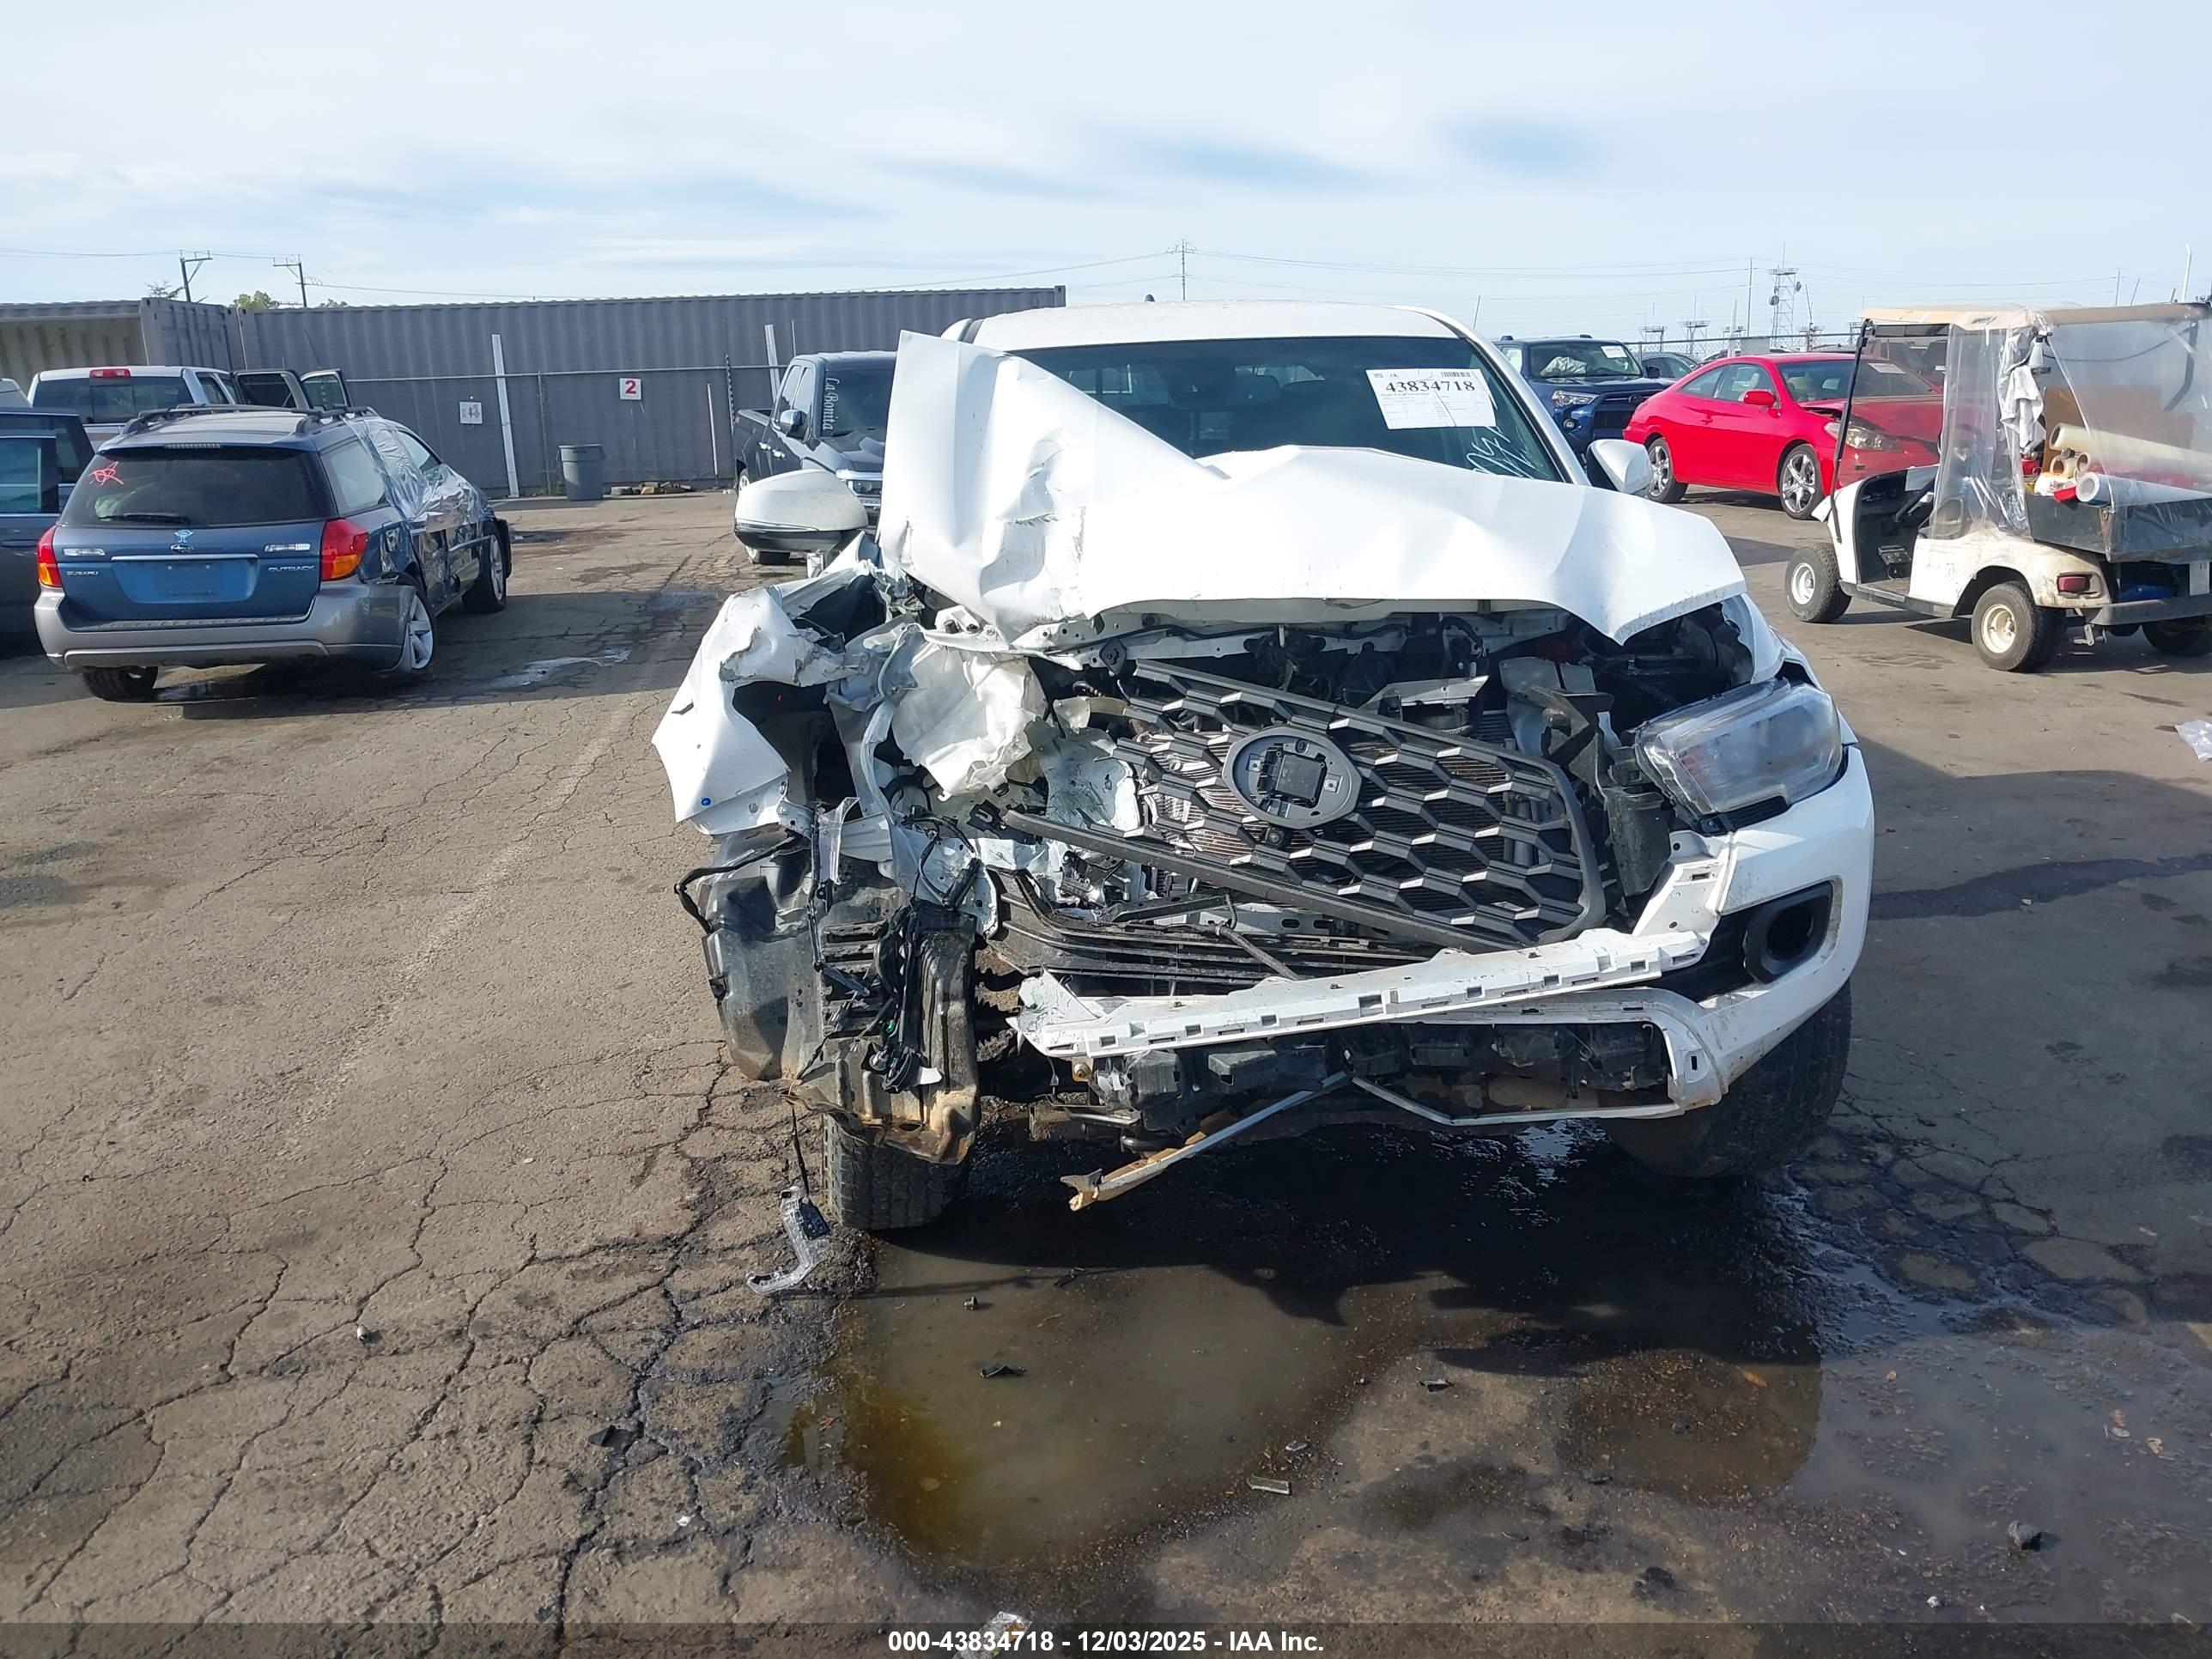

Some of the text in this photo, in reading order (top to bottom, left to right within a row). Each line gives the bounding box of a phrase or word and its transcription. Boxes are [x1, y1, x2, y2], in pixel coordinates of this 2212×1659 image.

[624, 380, 636, 394] 2
[1385, 380, 1475, 392] 43834718
[823, 377, 840, 431] La Bonita
